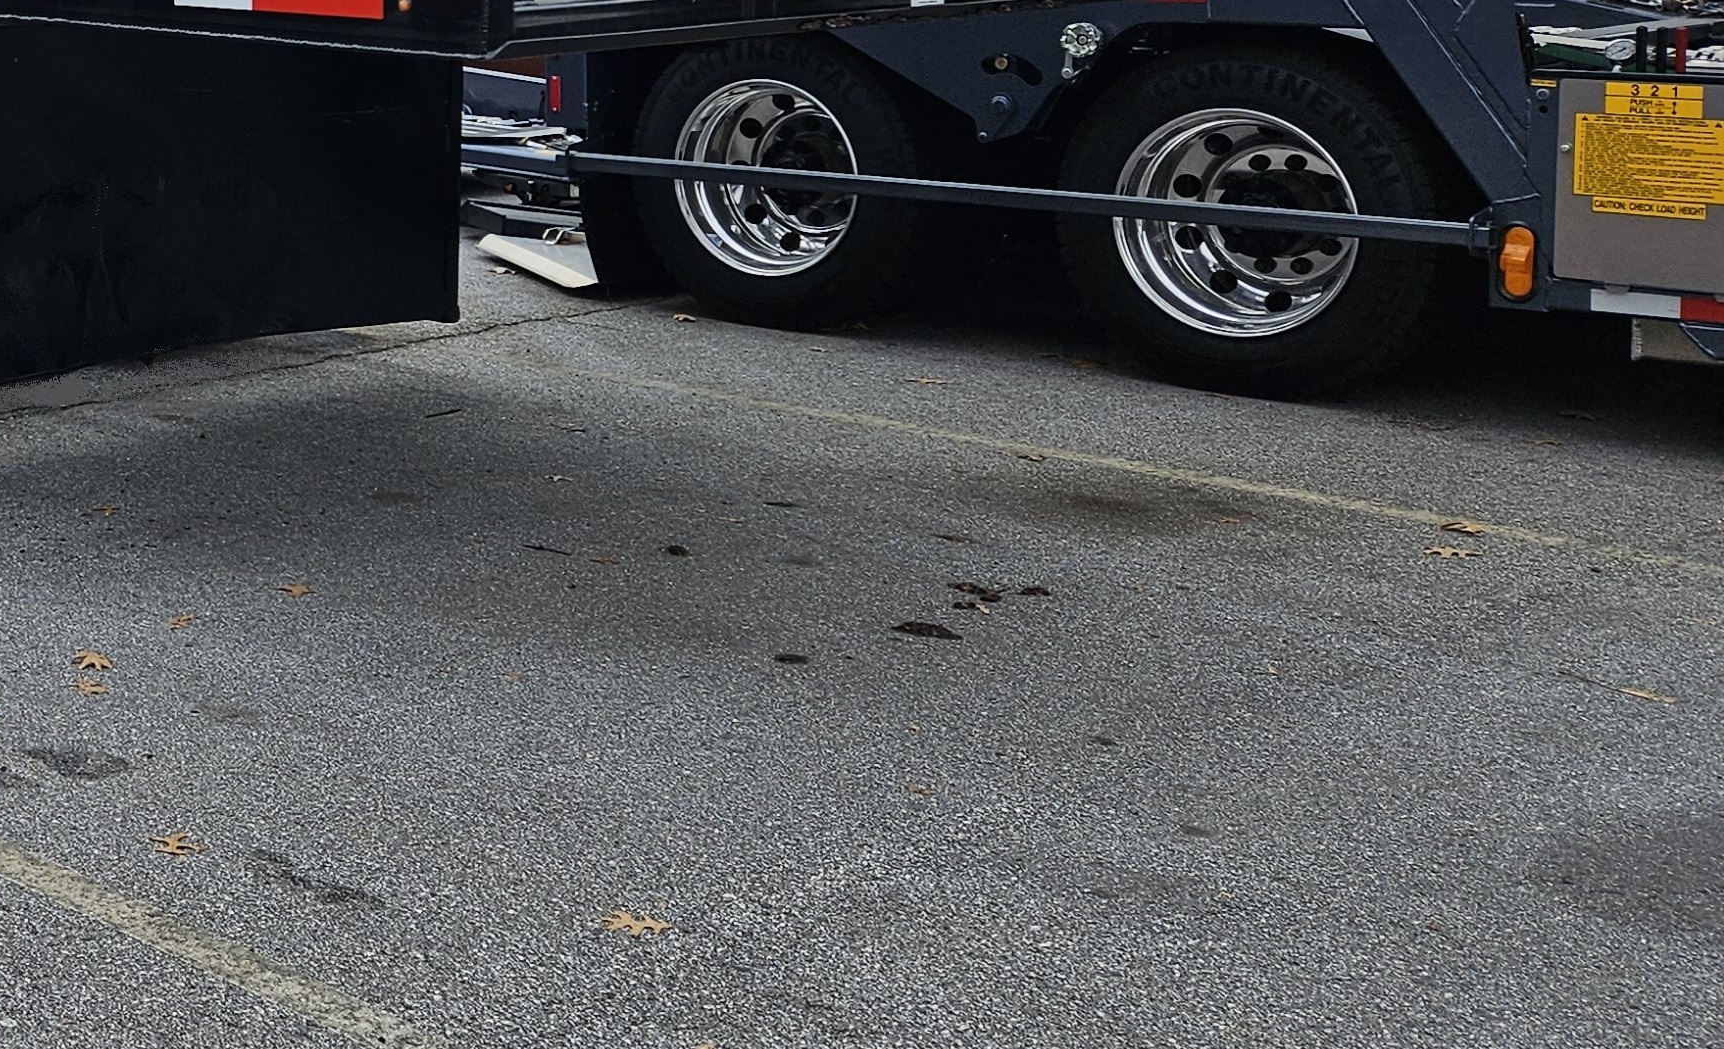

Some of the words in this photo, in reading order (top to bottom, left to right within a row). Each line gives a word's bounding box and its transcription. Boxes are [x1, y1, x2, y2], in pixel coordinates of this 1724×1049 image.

[1630, 83, 1641, 97] 3
[1650, 85, 1660, 97] 2
[1672, 86, 1678, 98] 1
[1629, 107, 1652, 115] PULL
[1629, 202, 1655, 213] CHECK
[1656, 204, 1676, 214] LOAD
[1678, 206, 1706, 216] HEIGHT
